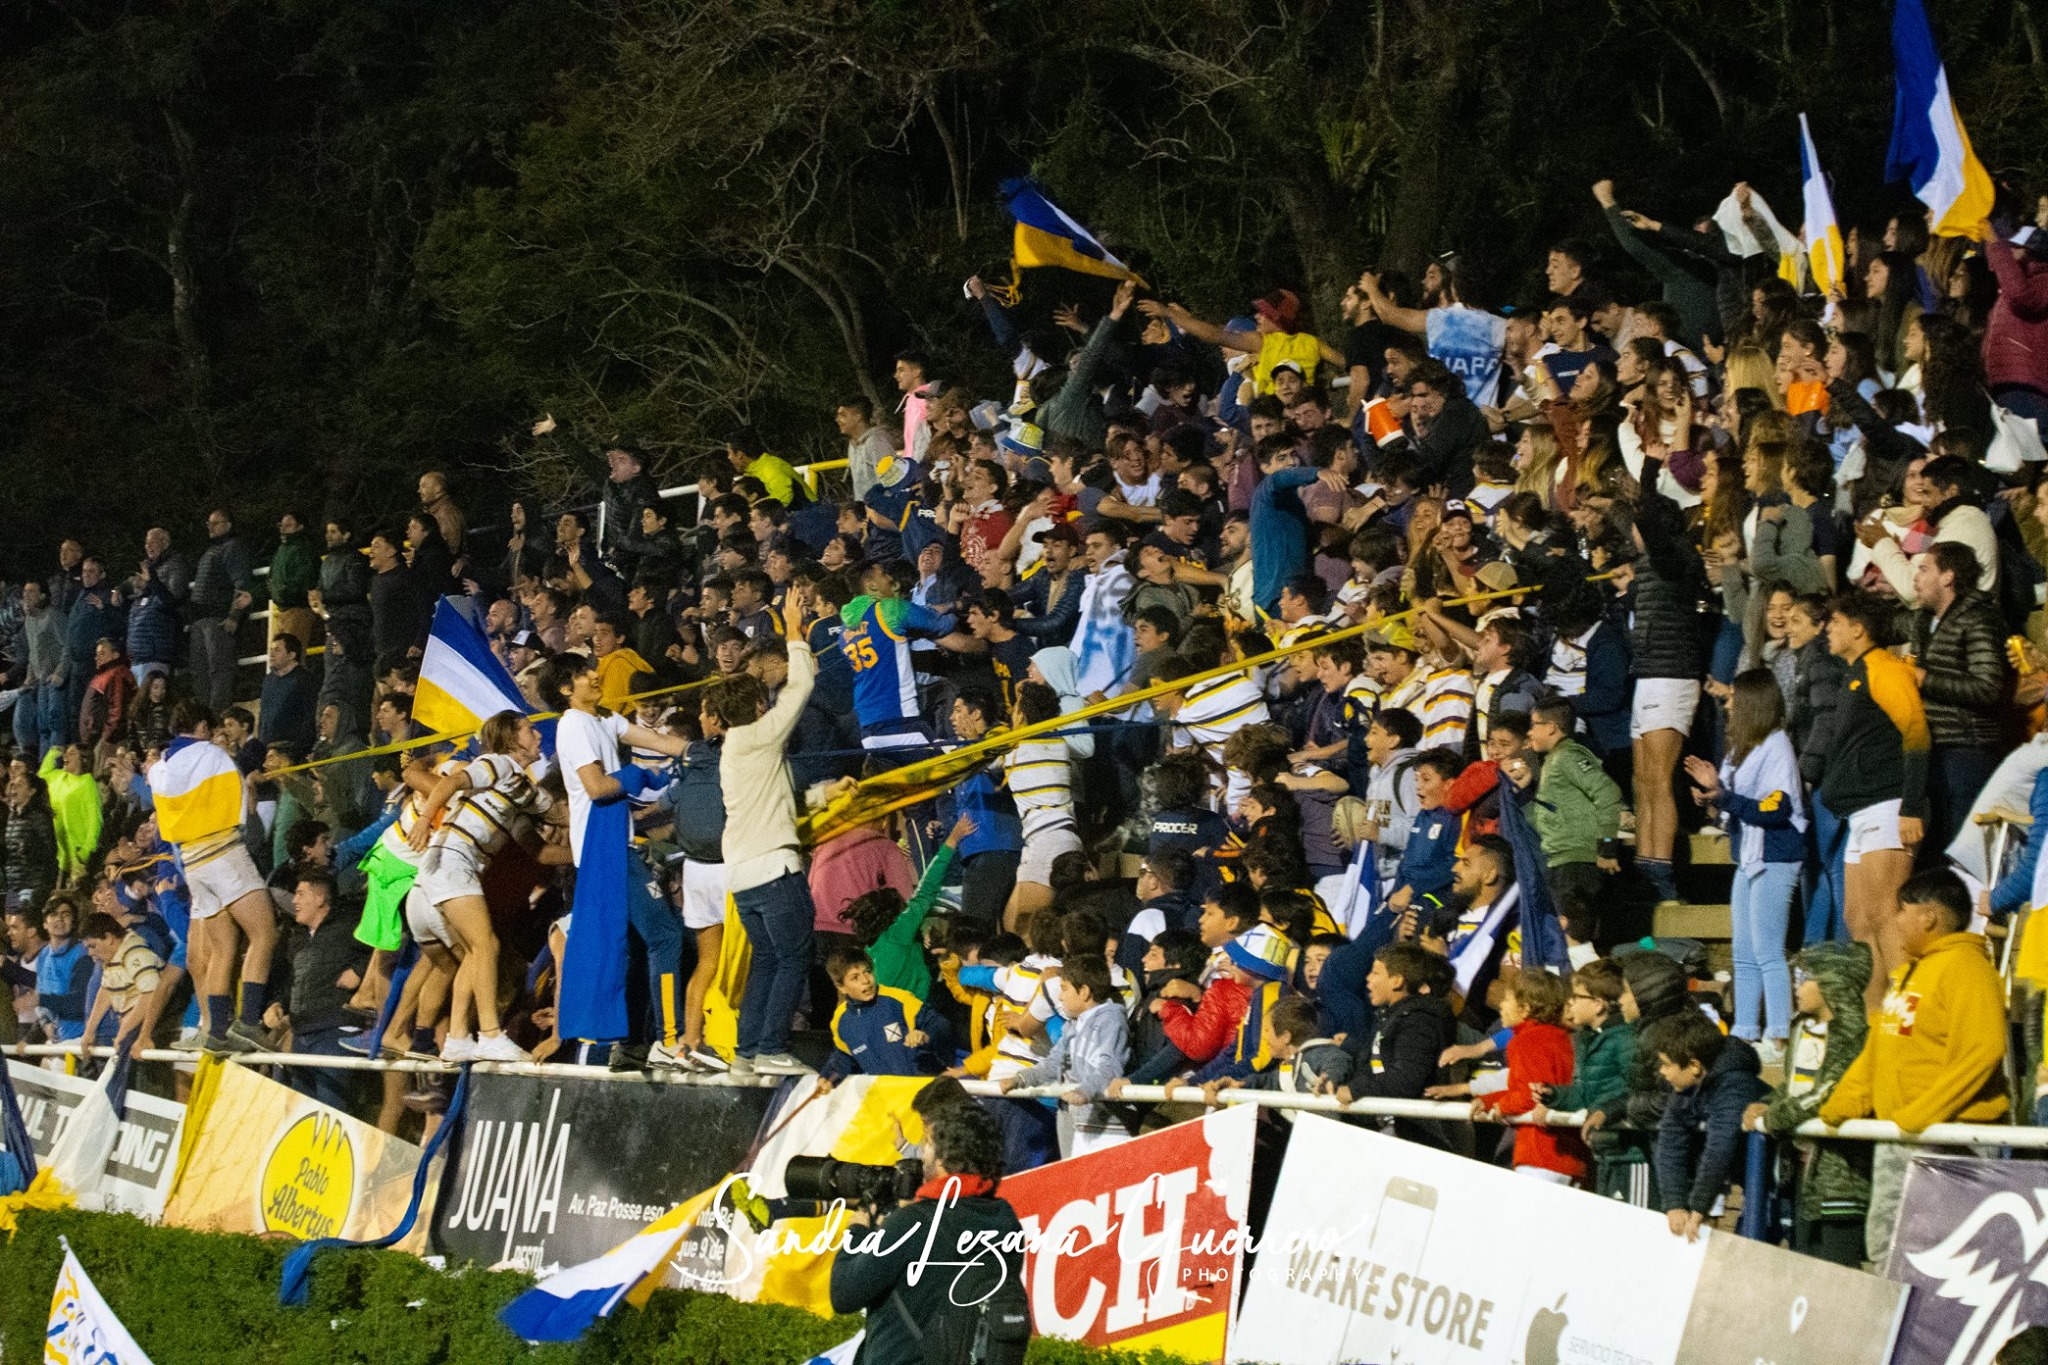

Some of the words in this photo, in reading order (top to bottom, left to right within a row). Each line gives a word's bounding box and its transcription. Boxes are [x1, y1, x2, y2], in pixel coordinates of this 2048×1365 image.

[843, 636, 879, 672] 35
[1152, 822, 1198, 835] PROCER
[294, 1157, 329, 1196] Pablo
[448, 1088, 571, 1262] JUANA
[267, 1183, 334, 1239] Albertus
[567, 1193, 584, 1215] Av.
[586, 1195, 607, 1218] Paz
[607, 1196, 642, 1221] Posse
[1286, 1238, 1387, 1317] WAKE
[1384, 1272, 1495, 1351] STORE
